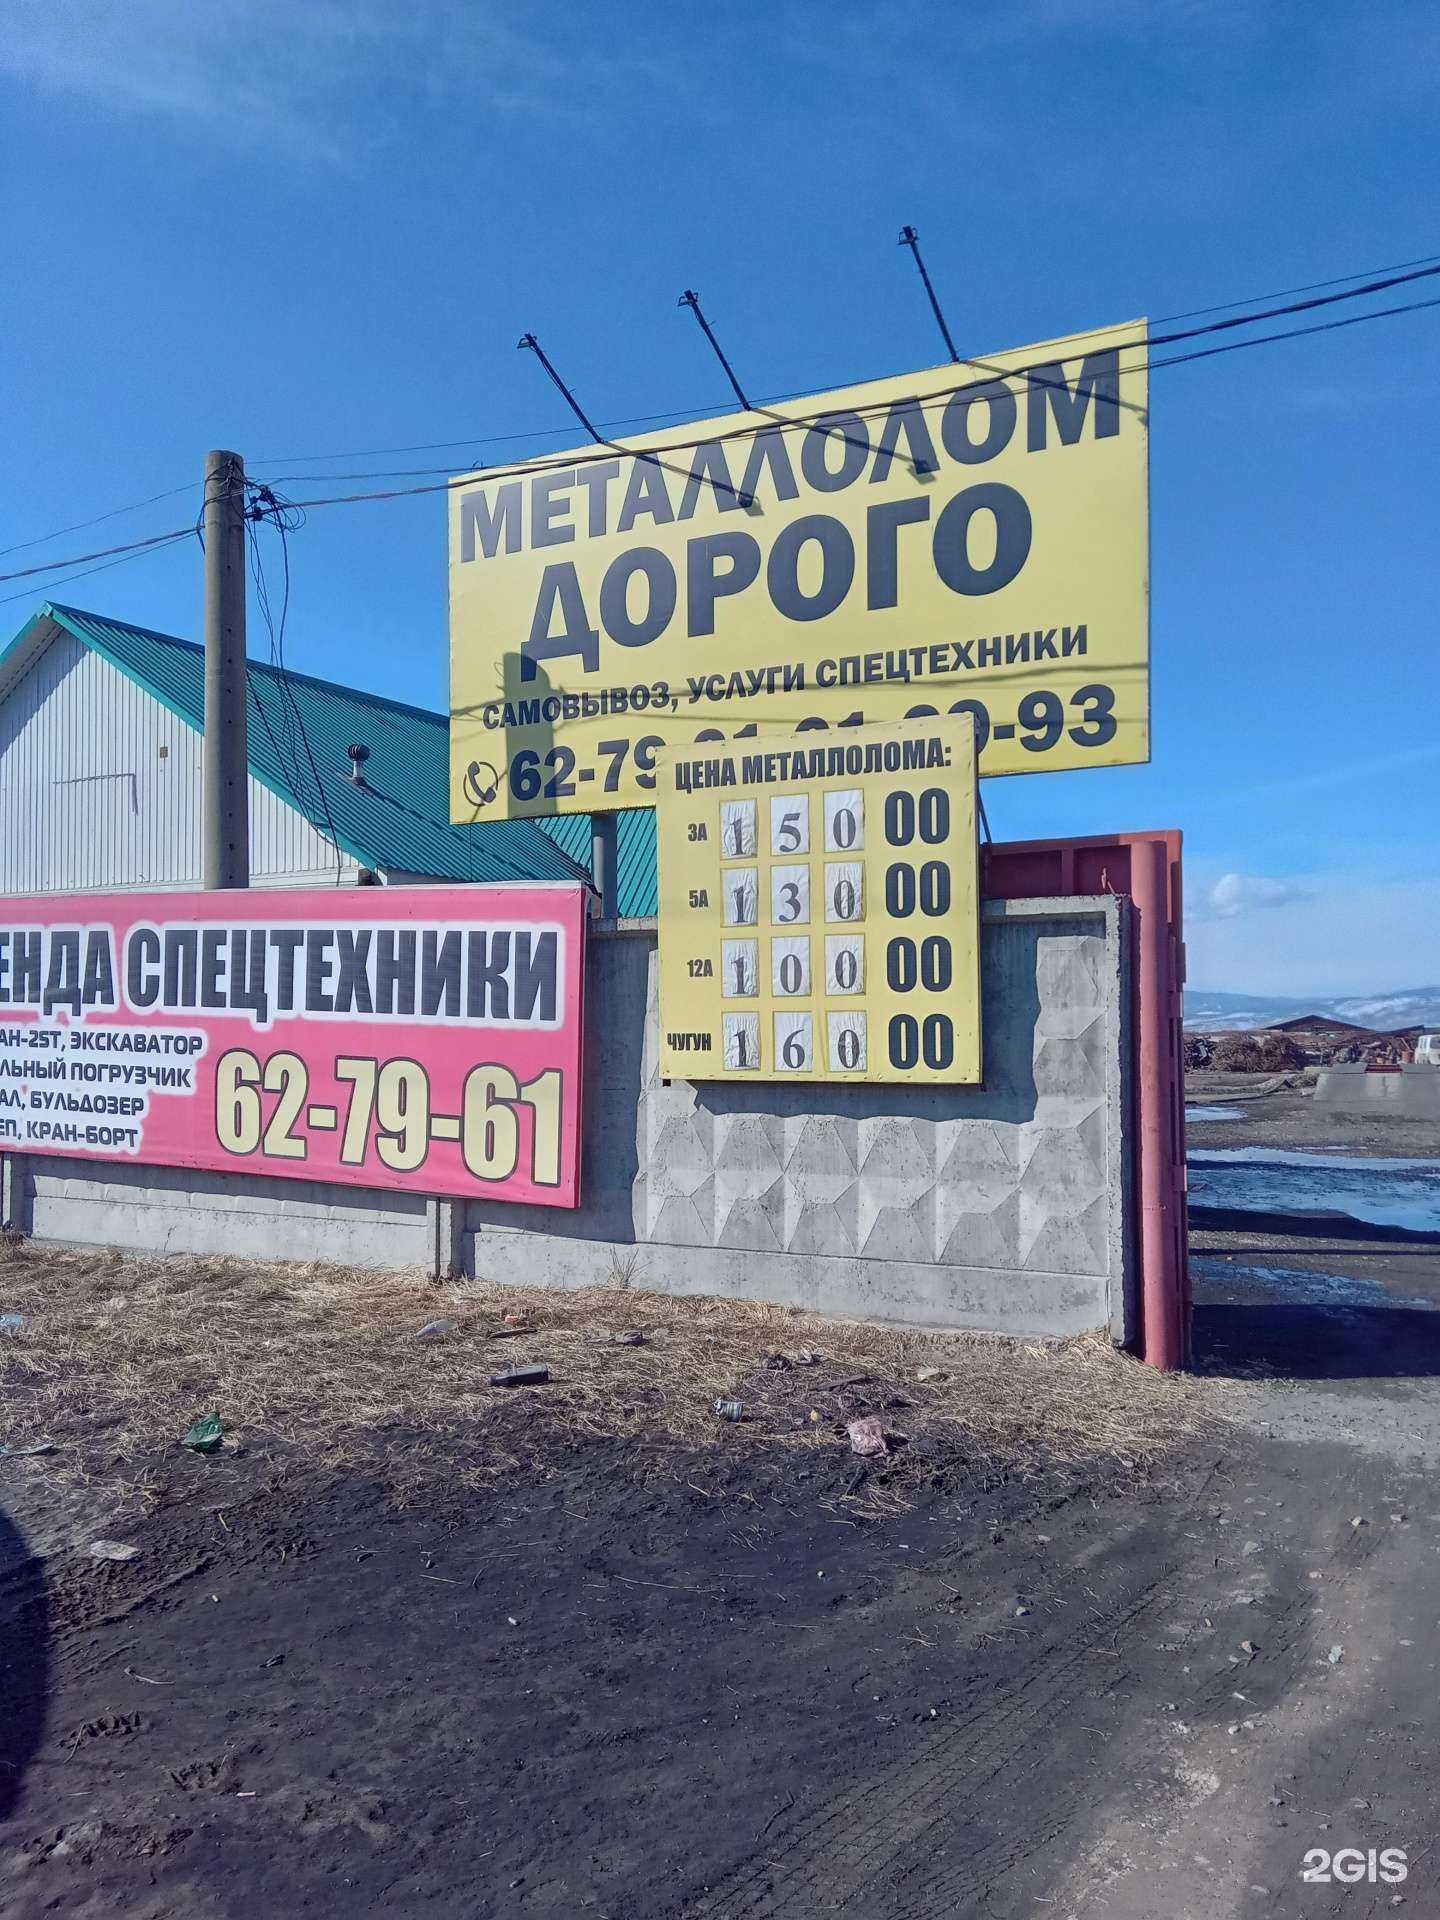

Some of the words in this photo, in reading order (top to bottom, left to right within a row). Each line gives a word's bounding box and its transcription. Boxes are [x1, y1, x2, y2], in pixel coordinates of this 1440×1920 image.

[461, 349, 1120, 563] МЕТАЛЛОЛОМ
[521, 482, 1032, 682] ДОРОГО
[482, 681, 678, 729] САМОВЫВОЗ,
[687, 663, 805, 704] УСЛУГИ
[816, 624, 1088, 688] СПЕЦТЕХНИКИ
[675, 757, 737, 794] ЦЕНА
[742, 737, 952, 785] МЕТАЛЛОЛОМА:
[127, 928, 557, 1022] СПЕЦТЕХНИКИ
[70, 1031, 203, 1055] ЭКСКАВАТОР
[667, 1032, 712, 1052] ЧУГУН
[30, 1090, 145, 1116] БУЛЬДОЗЕР
[70, 1062, 192, 1088] ПОГРУЗЧИК
[26, 1120, 139, 1147] КРАН-БОРТ
[215, 1047, 563, 1187] 62-79-61
